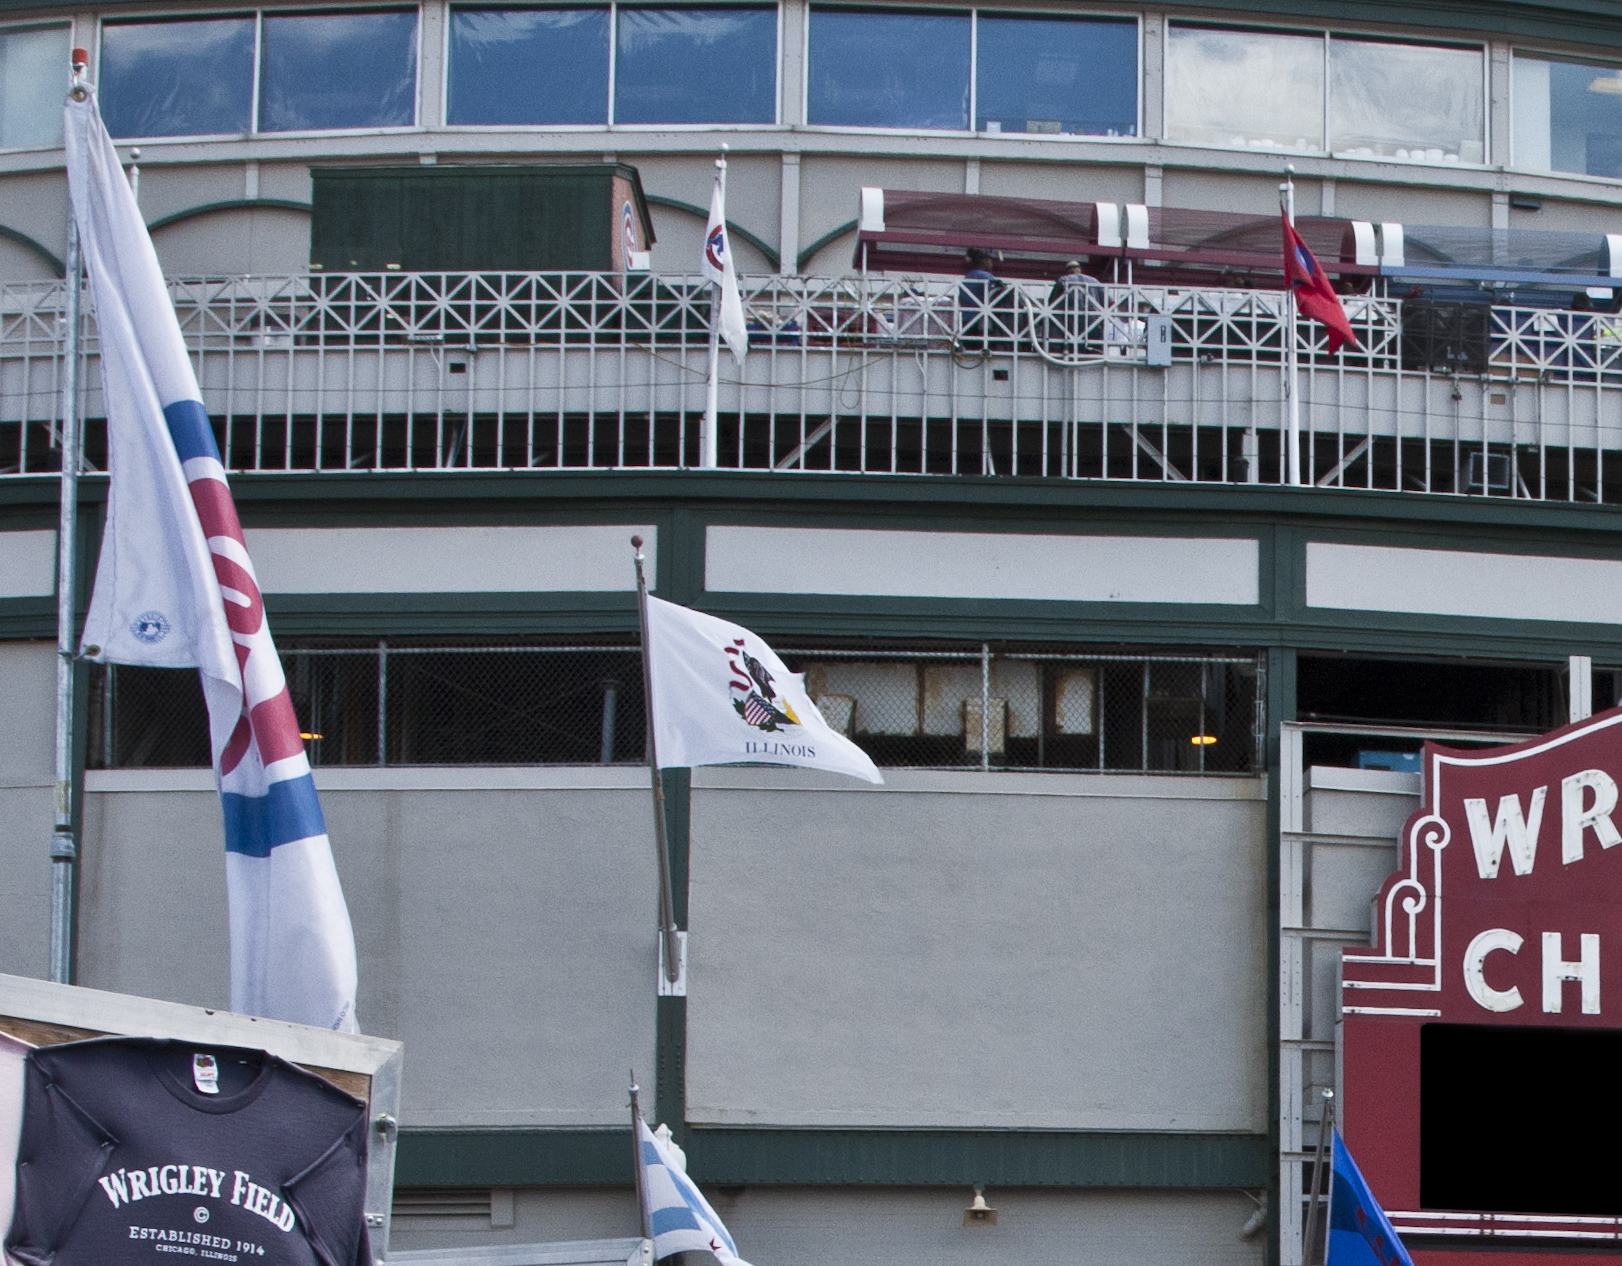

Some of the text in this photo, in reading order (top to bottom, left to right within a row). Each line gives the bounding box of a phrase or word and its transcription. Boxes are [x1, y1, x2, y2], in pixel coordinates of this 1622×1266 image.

[746, 741, 816, 758] ILLINOIS
[98, 1164, 297, 1234] WRIGLEY FIELD
[128, 1226, 265, 1256] ESTABLISHED 1914
[155, 1244, 238, 1262] CHICAGO, ILLINOIS
